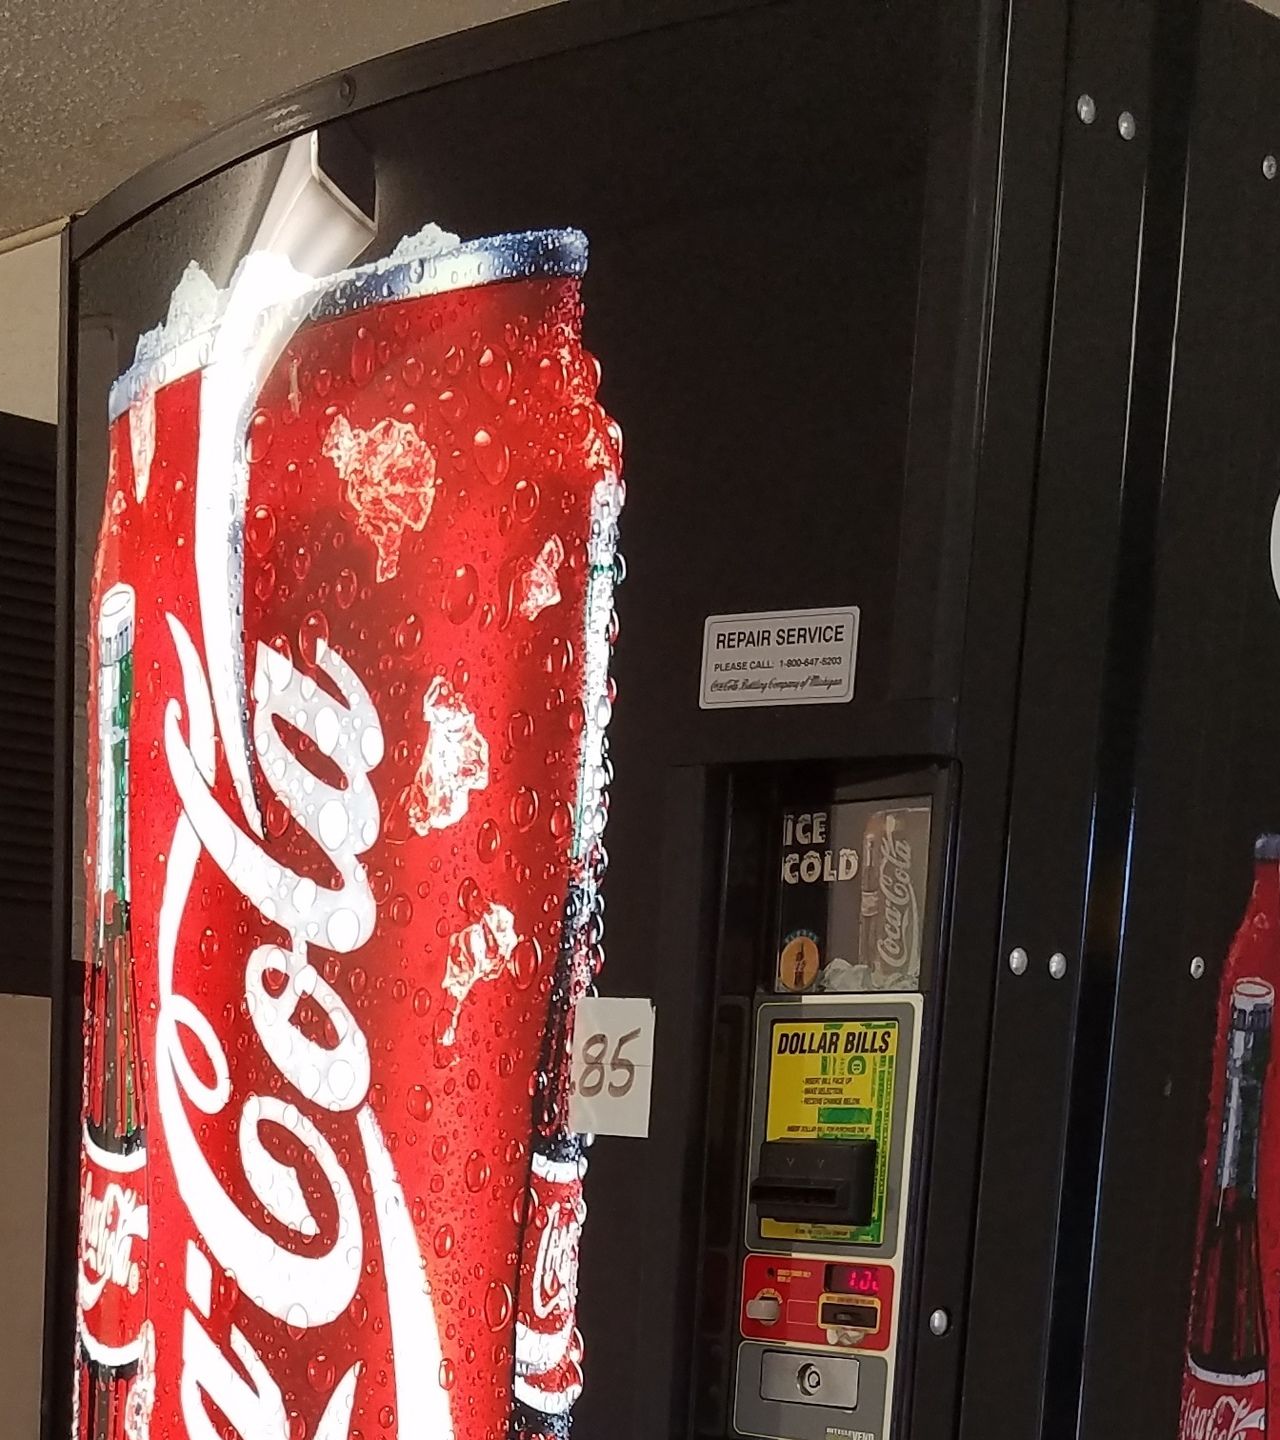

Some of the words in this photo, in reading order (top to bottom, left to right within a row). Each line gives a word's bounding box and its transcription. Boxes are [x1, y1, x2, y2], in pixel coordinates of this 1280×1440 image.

[716, 630, 771, 650] REPAIR
[776, 624, 845, 647] SERVICE
[714, 661, 748, 673] PLEASE
[783, 812, 827, 847] ICE
[782, 848, 859, 885] COLD
[777, 1031, 840, 1054] DOLLAR
[843, 1030, 891, 1054] BILLS
